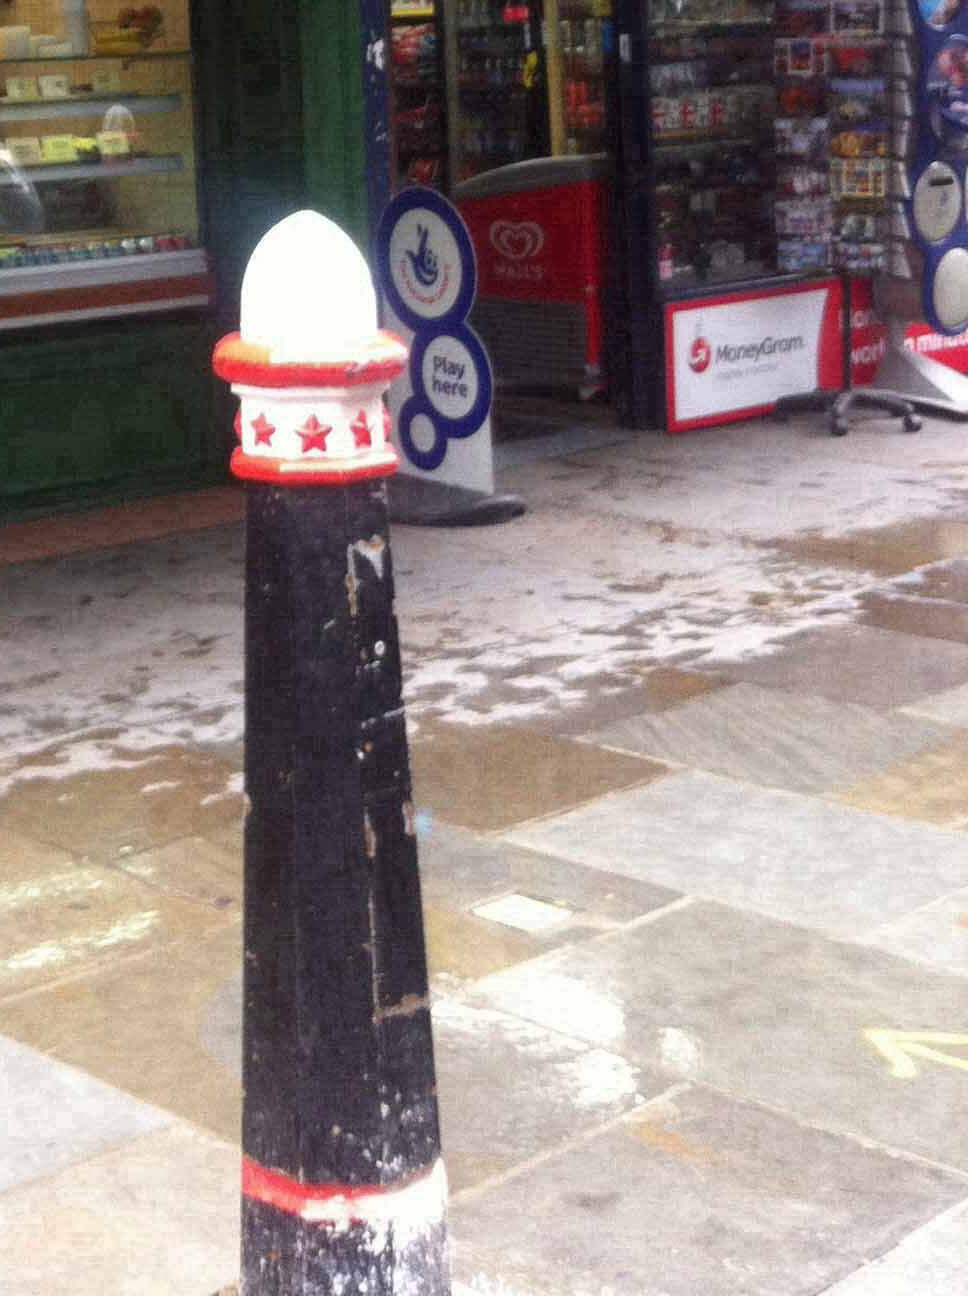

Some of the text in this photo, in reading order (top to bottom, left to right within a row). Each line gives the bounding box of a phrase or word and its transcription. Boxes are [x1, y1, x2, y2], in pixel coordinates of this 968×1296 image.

[715, 335, 804, 363] MoneyGram
[433, 355, 466, 380] Play
[433, 375, 468, 399] here
